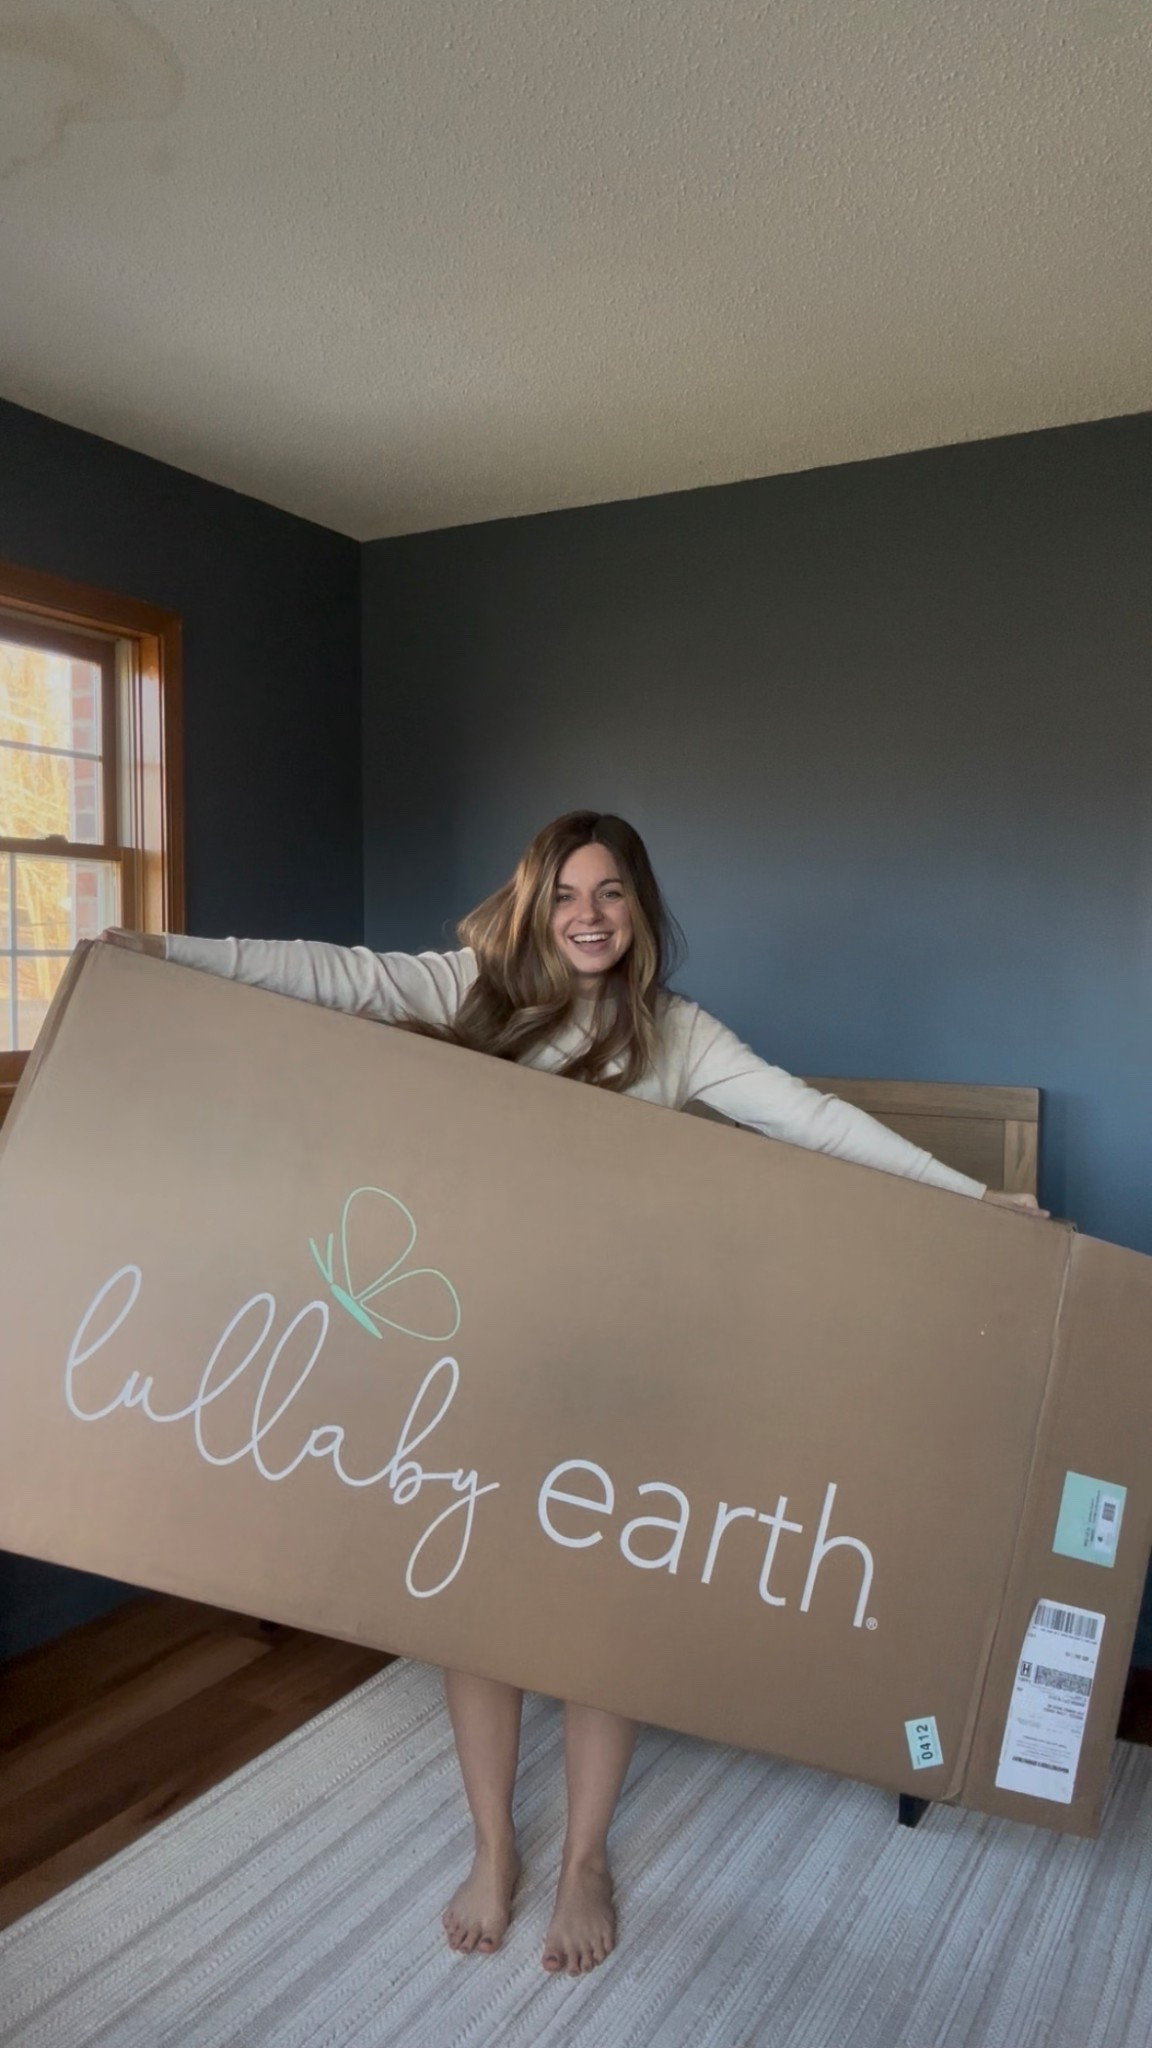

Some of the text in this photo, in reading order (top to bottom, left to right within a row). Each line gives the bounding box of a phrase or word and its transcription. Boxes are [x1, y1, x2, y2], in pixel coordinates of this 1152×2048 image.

[65, 1264, 876, 1629] lullaby earth
[916, 1724, 933, 1760] 0412
